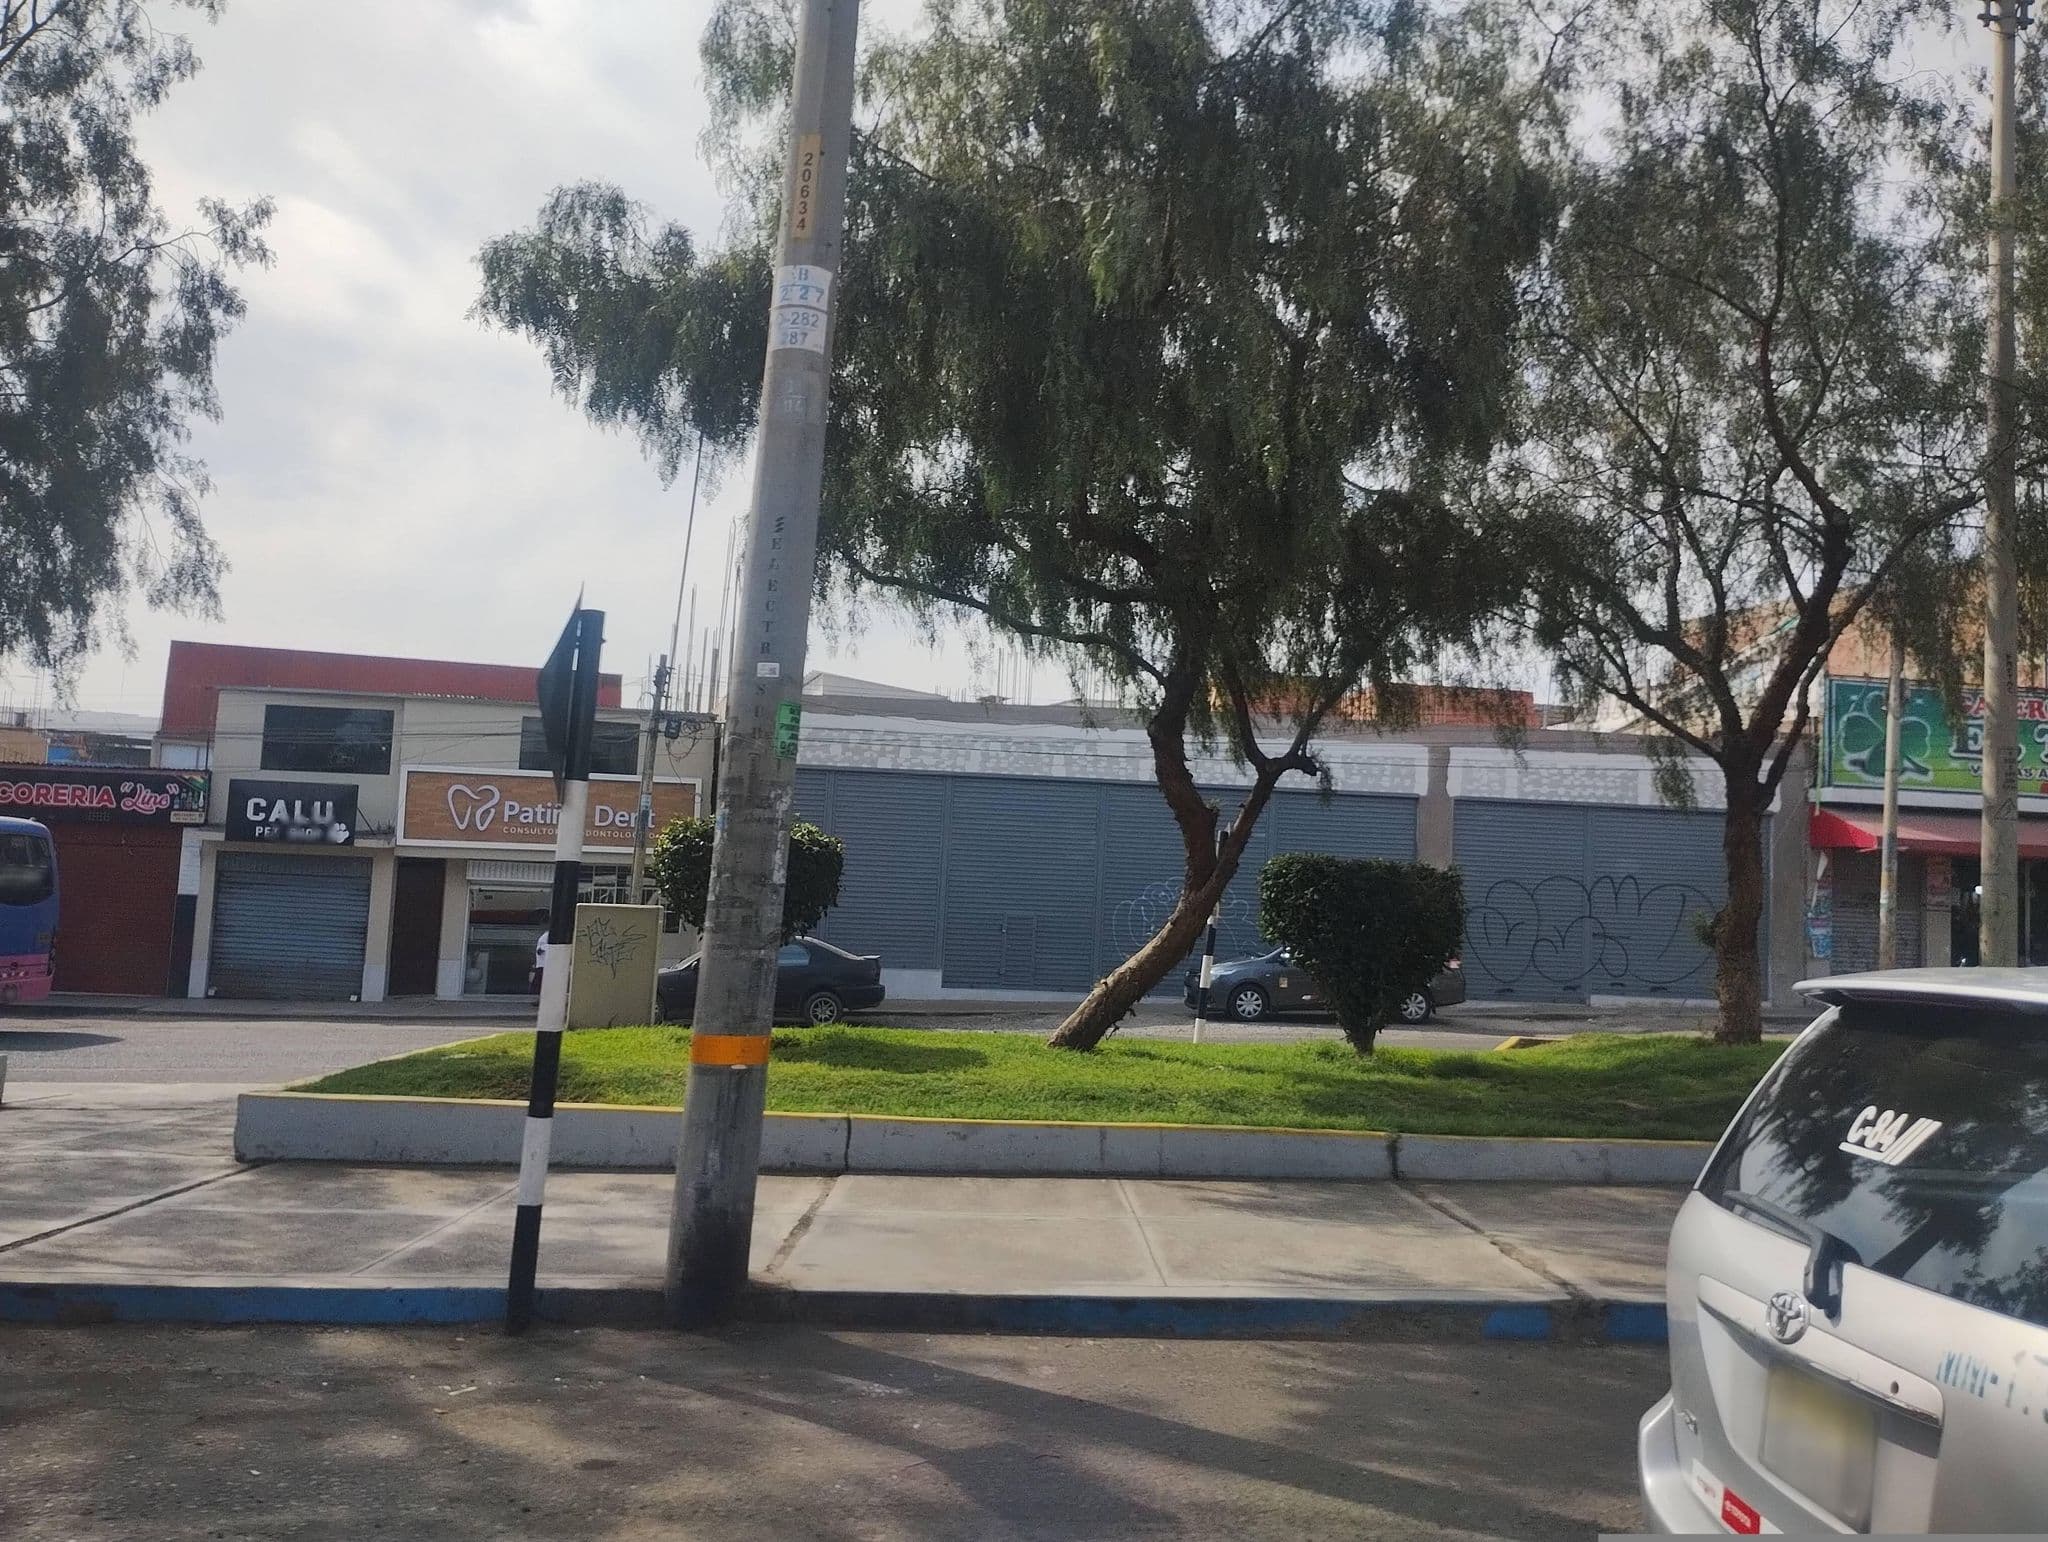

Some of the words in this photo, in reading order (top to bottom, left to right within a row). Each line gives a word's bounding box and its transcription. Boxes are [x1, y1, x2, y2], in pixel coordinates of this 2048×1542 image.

[796, 151, 814, 232] 20634
[246, 797, 334, 825] CALU
[503, 800, 561, 825] Pati
[1846, 1105, 1909, 1153] C-84
